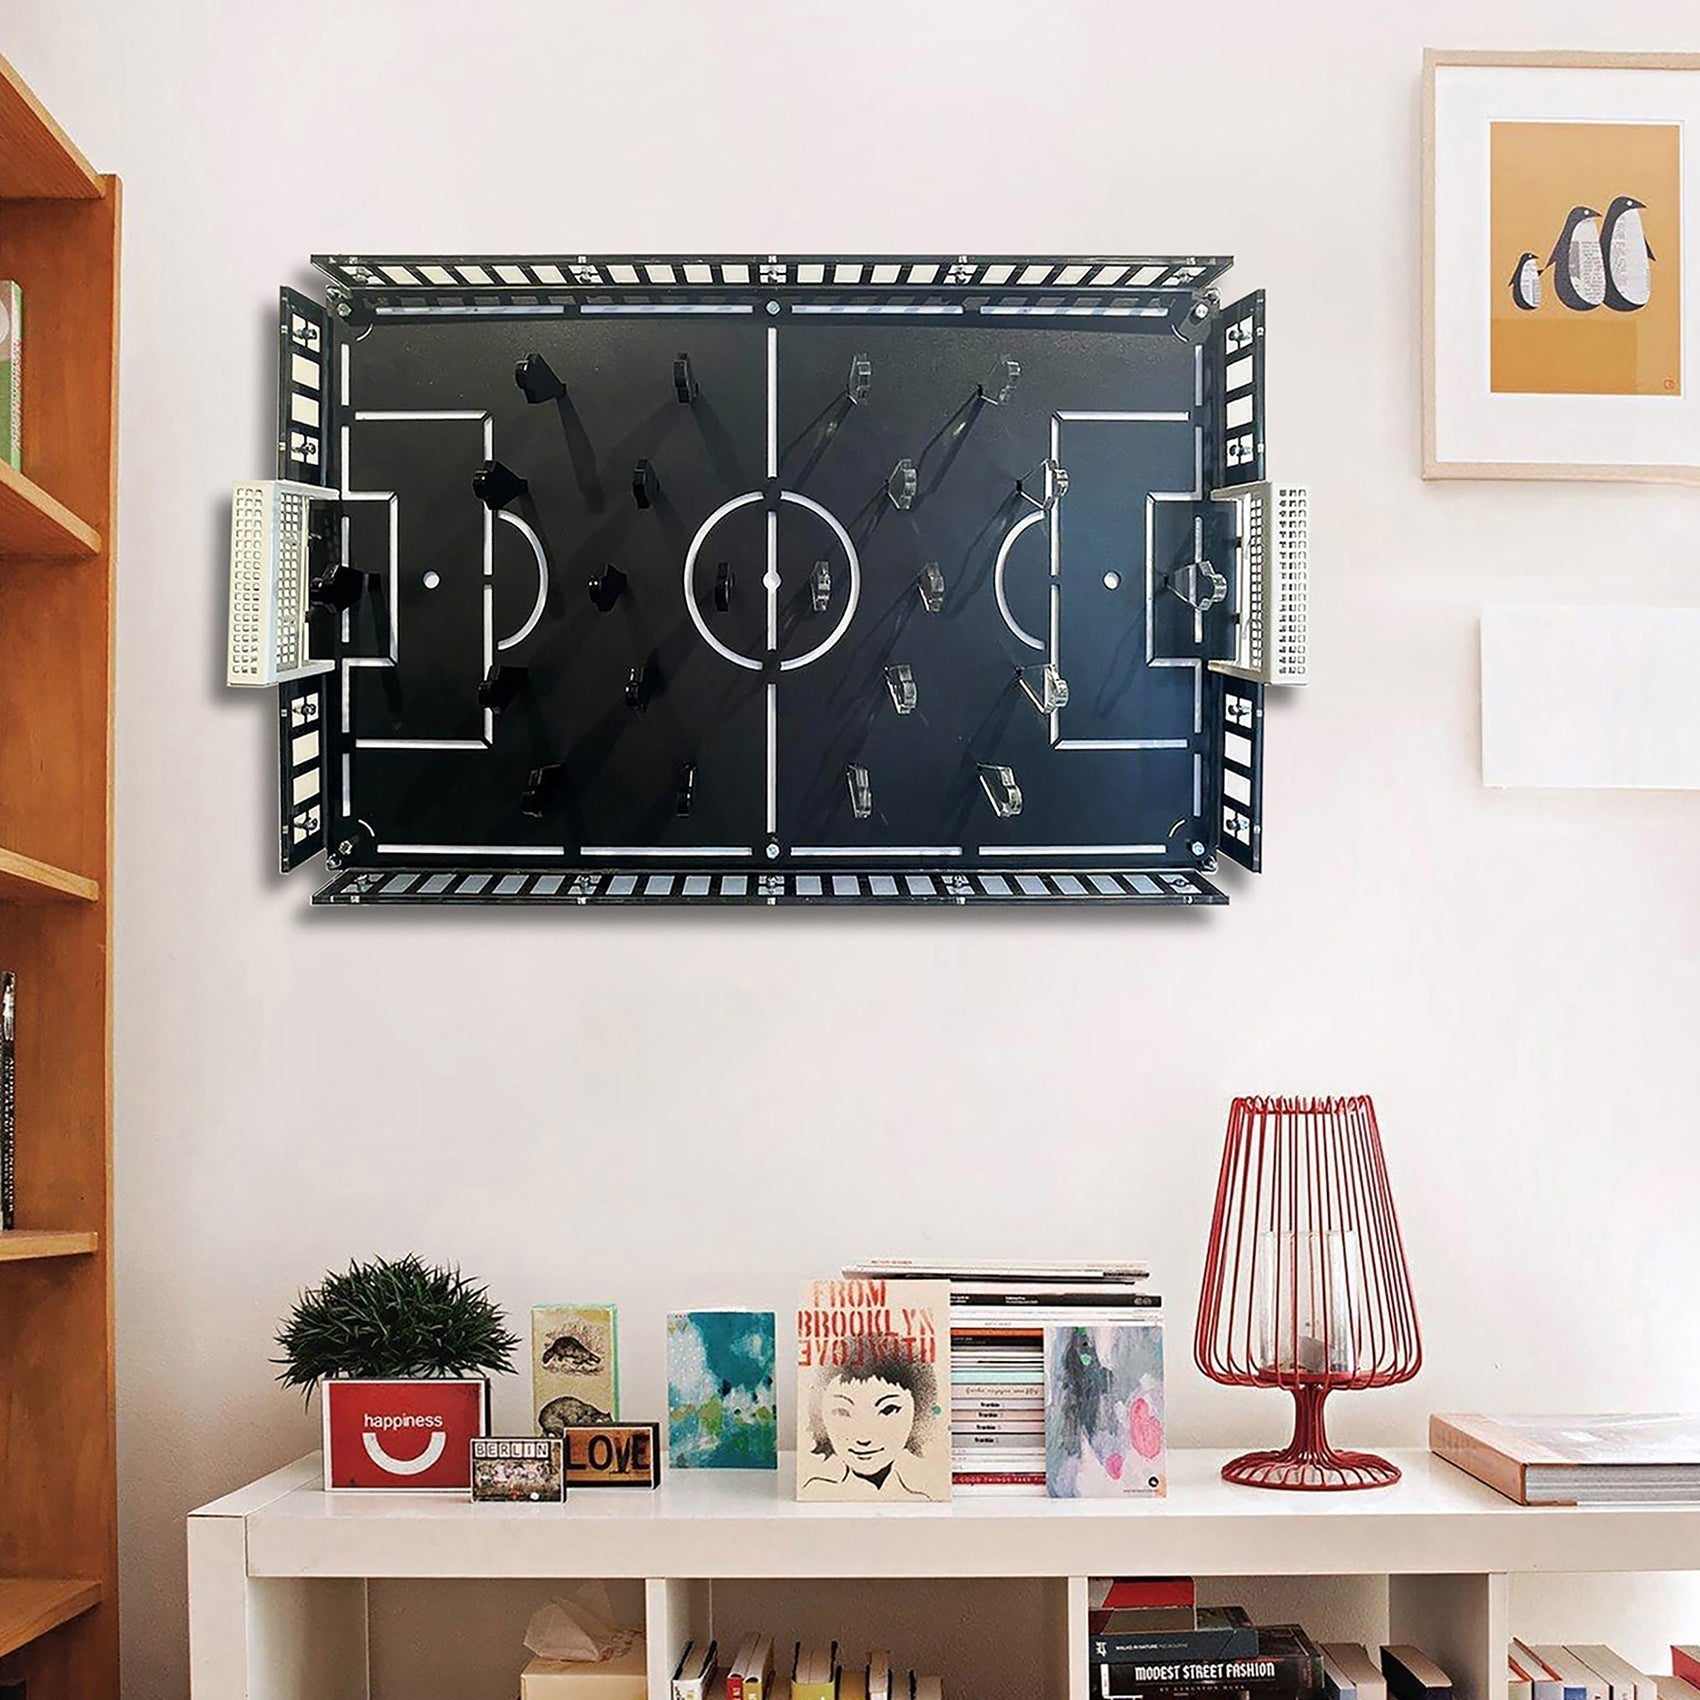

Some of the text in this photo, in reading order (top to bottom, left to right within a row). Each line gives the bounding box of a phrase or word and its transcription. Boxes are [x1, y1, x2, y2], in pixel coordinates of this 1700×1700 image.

[813, 1279, 886, 1308] FROM
[797, 1308, 935, 1337] BROOKLYN
[363, 1412, 444, 1431] happiness
[474, 1443, 549, 1458] BERLIN
[566, 1433, 650, 1474] LOVE
[1134, 1662, 1275, 1681] MODEST STREET FASHION
